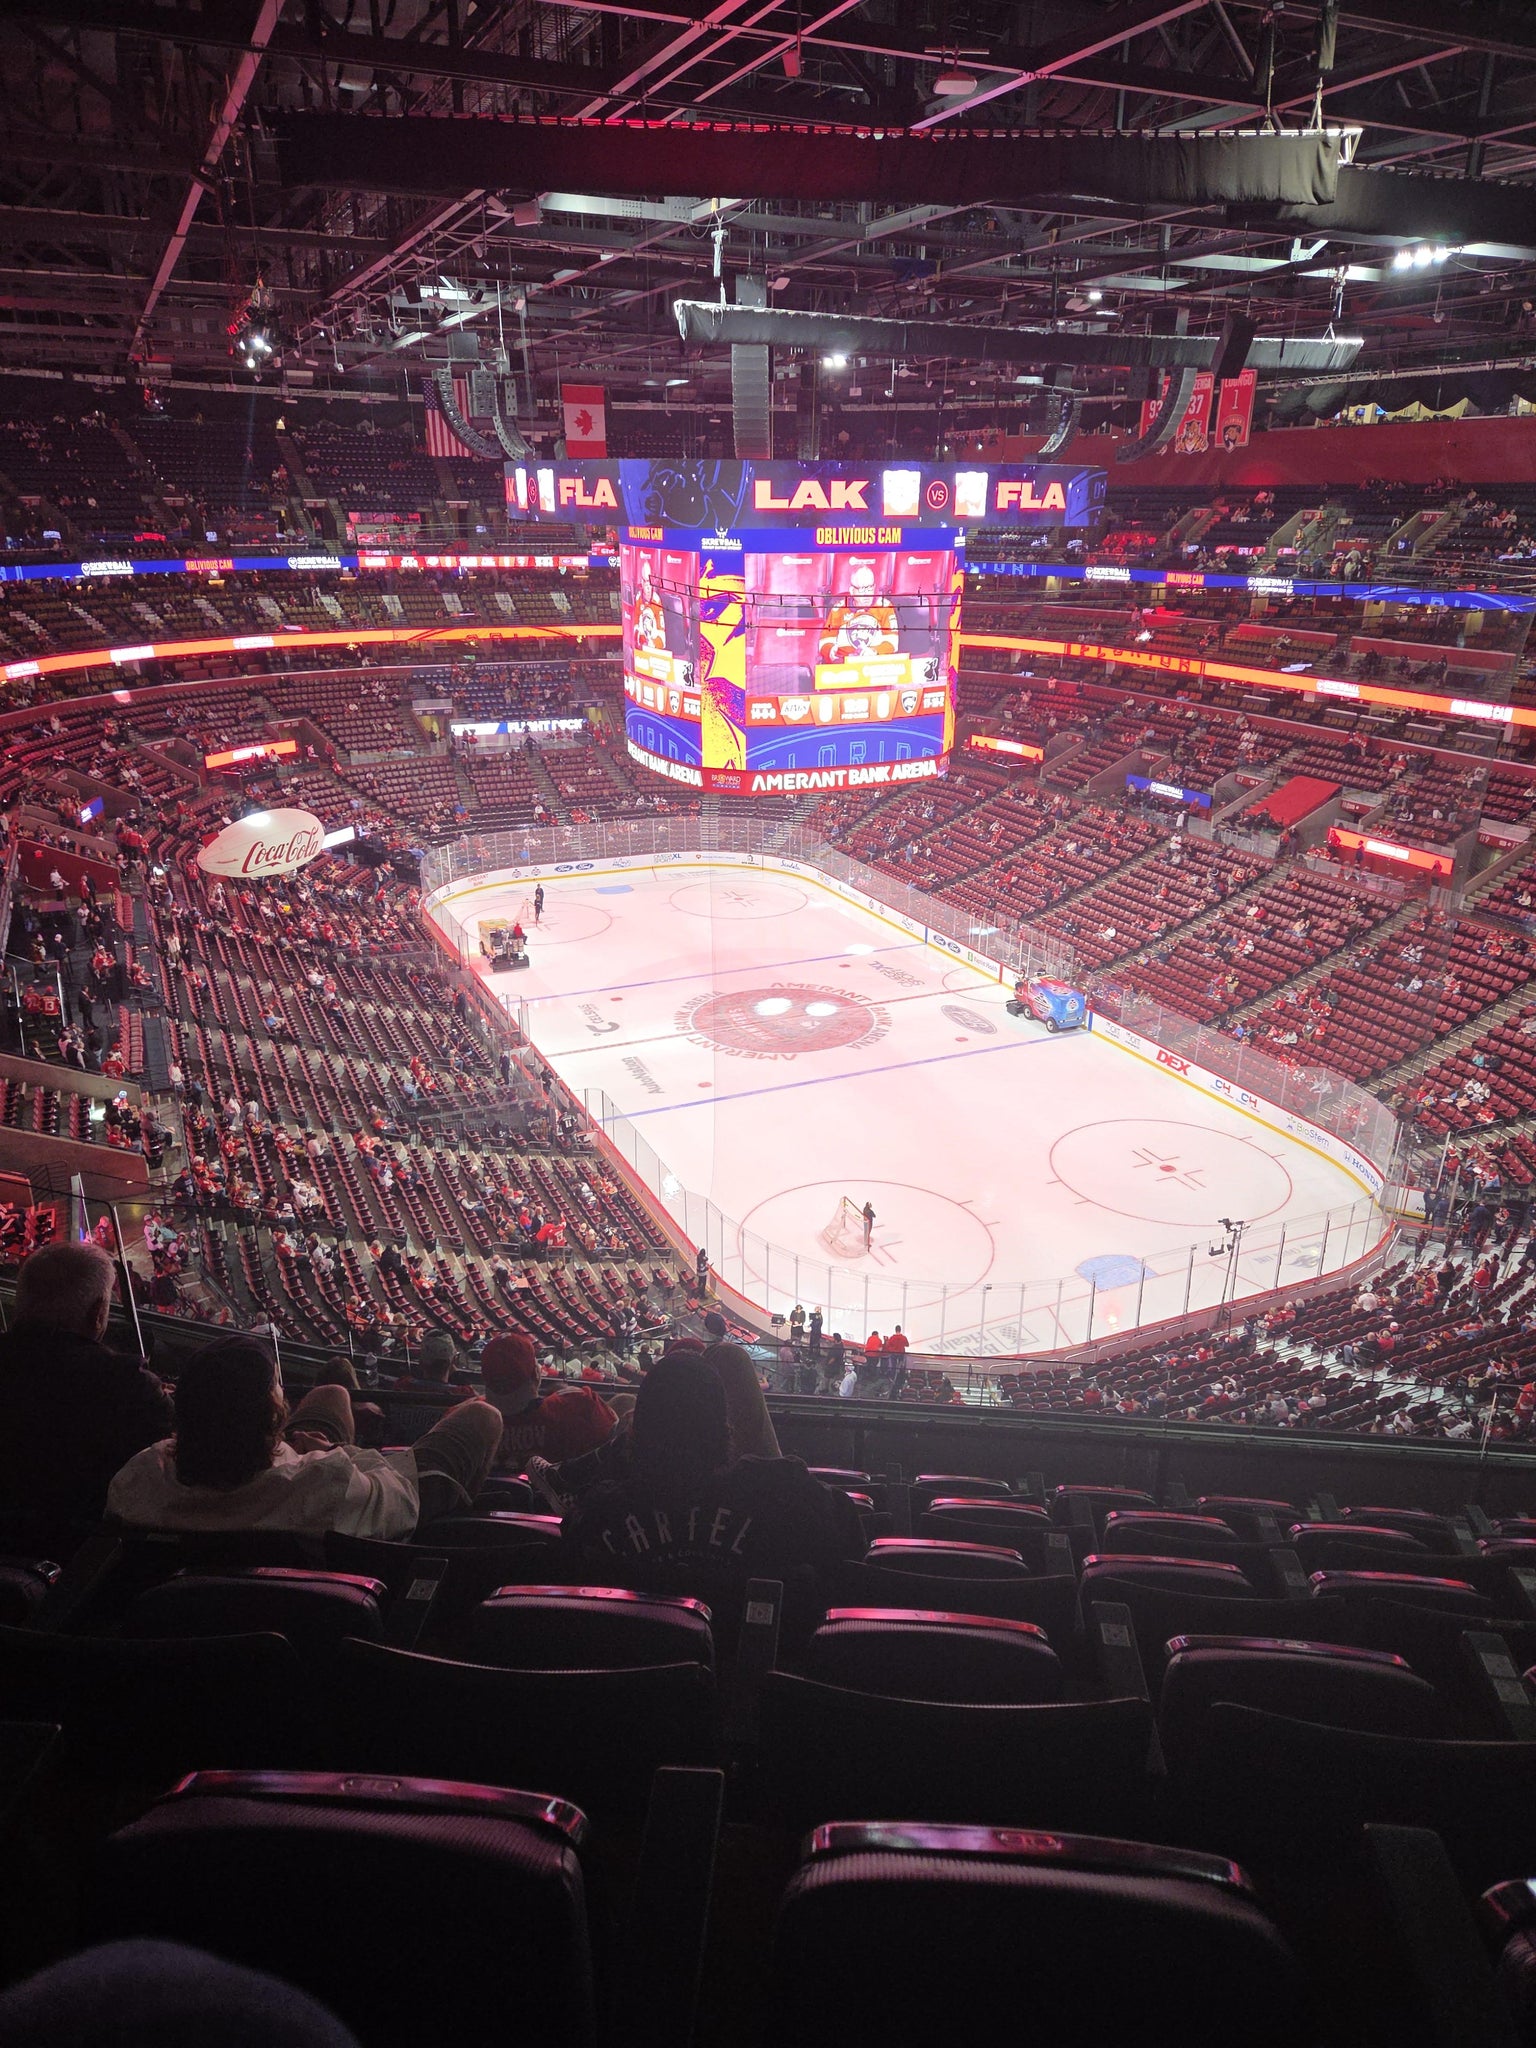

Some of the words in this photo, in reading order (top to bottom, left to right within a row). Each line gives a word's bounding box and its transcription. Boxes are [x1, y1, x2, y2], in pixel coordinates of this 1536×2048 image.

[1188, 394, 1204, 415] 37
[1231, 389, 1239, 410] 1
[559, 478, 618, 507] FLA
[755, 480, 869, 509] LAK
[931, 490, 945, 501] VS
[996, 482, 1066, 509] FLA
[701, 538, 742, 546] SKREWBALL
[816, 528, 877, 545] OBLIVIOUS
[877, 528, 902, 543] CAM
[185, 560, 219, 571] OBLIVIOUS
[219, 559, 233, 570] CAM
[669, 762, 703, 787] ARENA
[752, 770, 848, 792] AMERANT
[848, 766, 892, 786] BANK
[891, 759, 938, 781] ARENA
[682, 990, 727, 1016] ARENA
[770, 982, 873, 1002] AMERANT
[673, 1010, 692, 1031] BANK
[870, 1006, 893, 1027] BANK
[687, 1035, 799, 1061] AMERANT
[846, 1026, 890, 1050] ARENA
[621, 1056, 665, 1094] AutoNation
[1156, 1050, 1192, 1076] DEX
[1296, 1122, 1330, 1147] BioStem
[1352, 1158, 1381, 1191] HONDA
[602, 1507, 752, 1556] CARTEL
